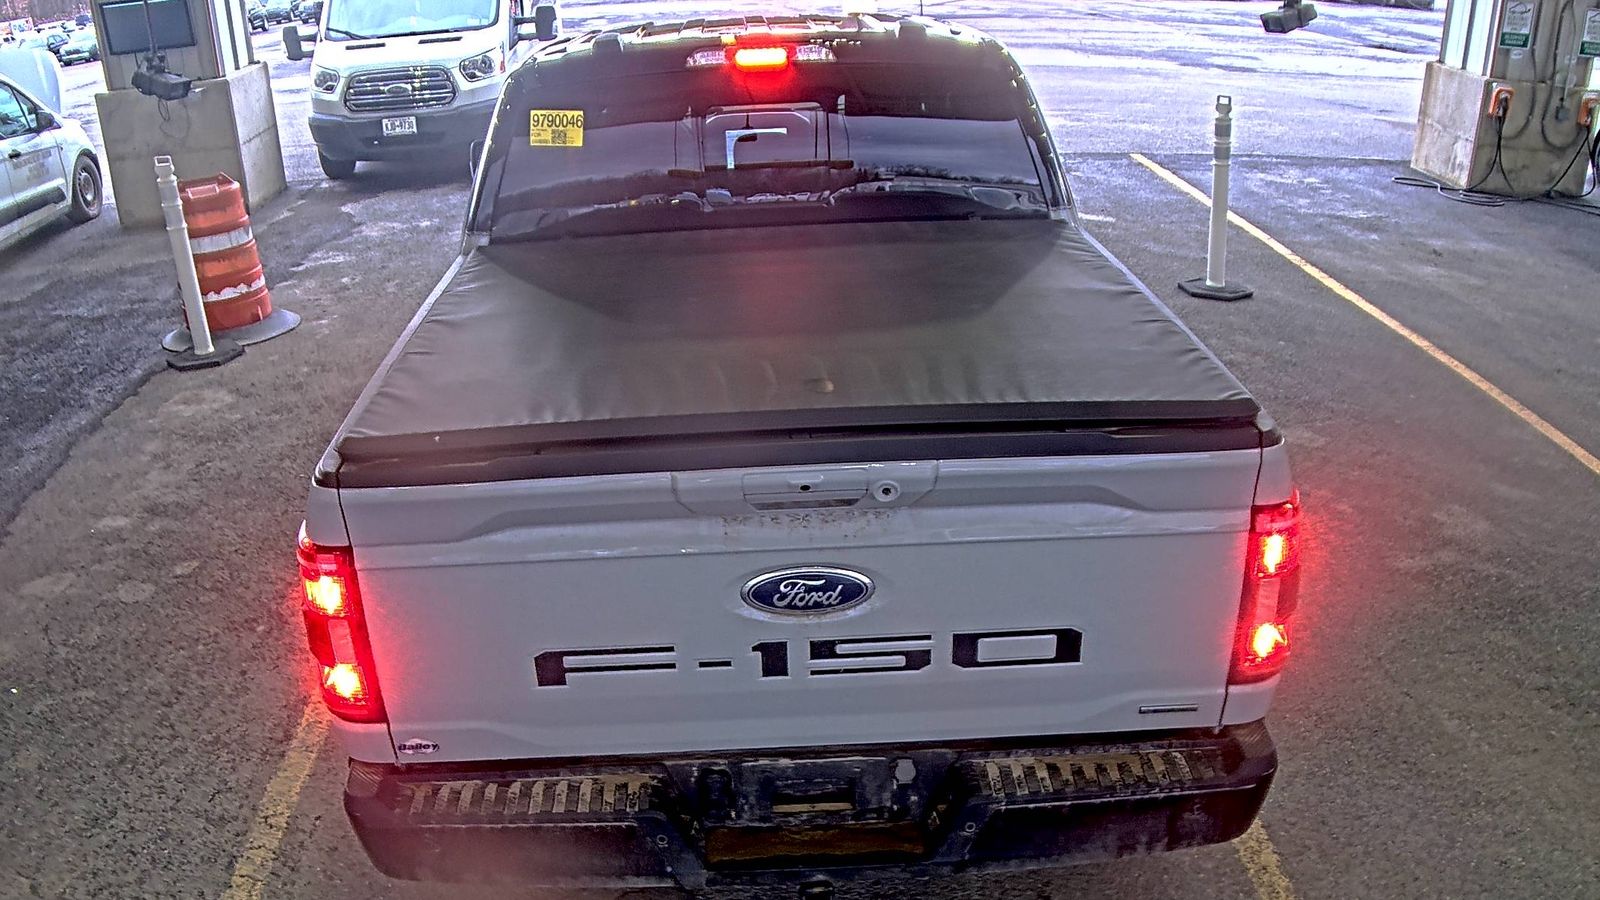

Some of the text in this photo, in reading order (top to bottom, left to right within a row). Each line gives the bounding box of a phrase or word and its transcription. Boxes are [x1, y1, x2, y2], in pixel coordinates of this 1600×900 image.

[532, 113, 584, 128] 9790046
[773, 579, 844, 607] Ford
[535, 628, 1082, 687] F-150
